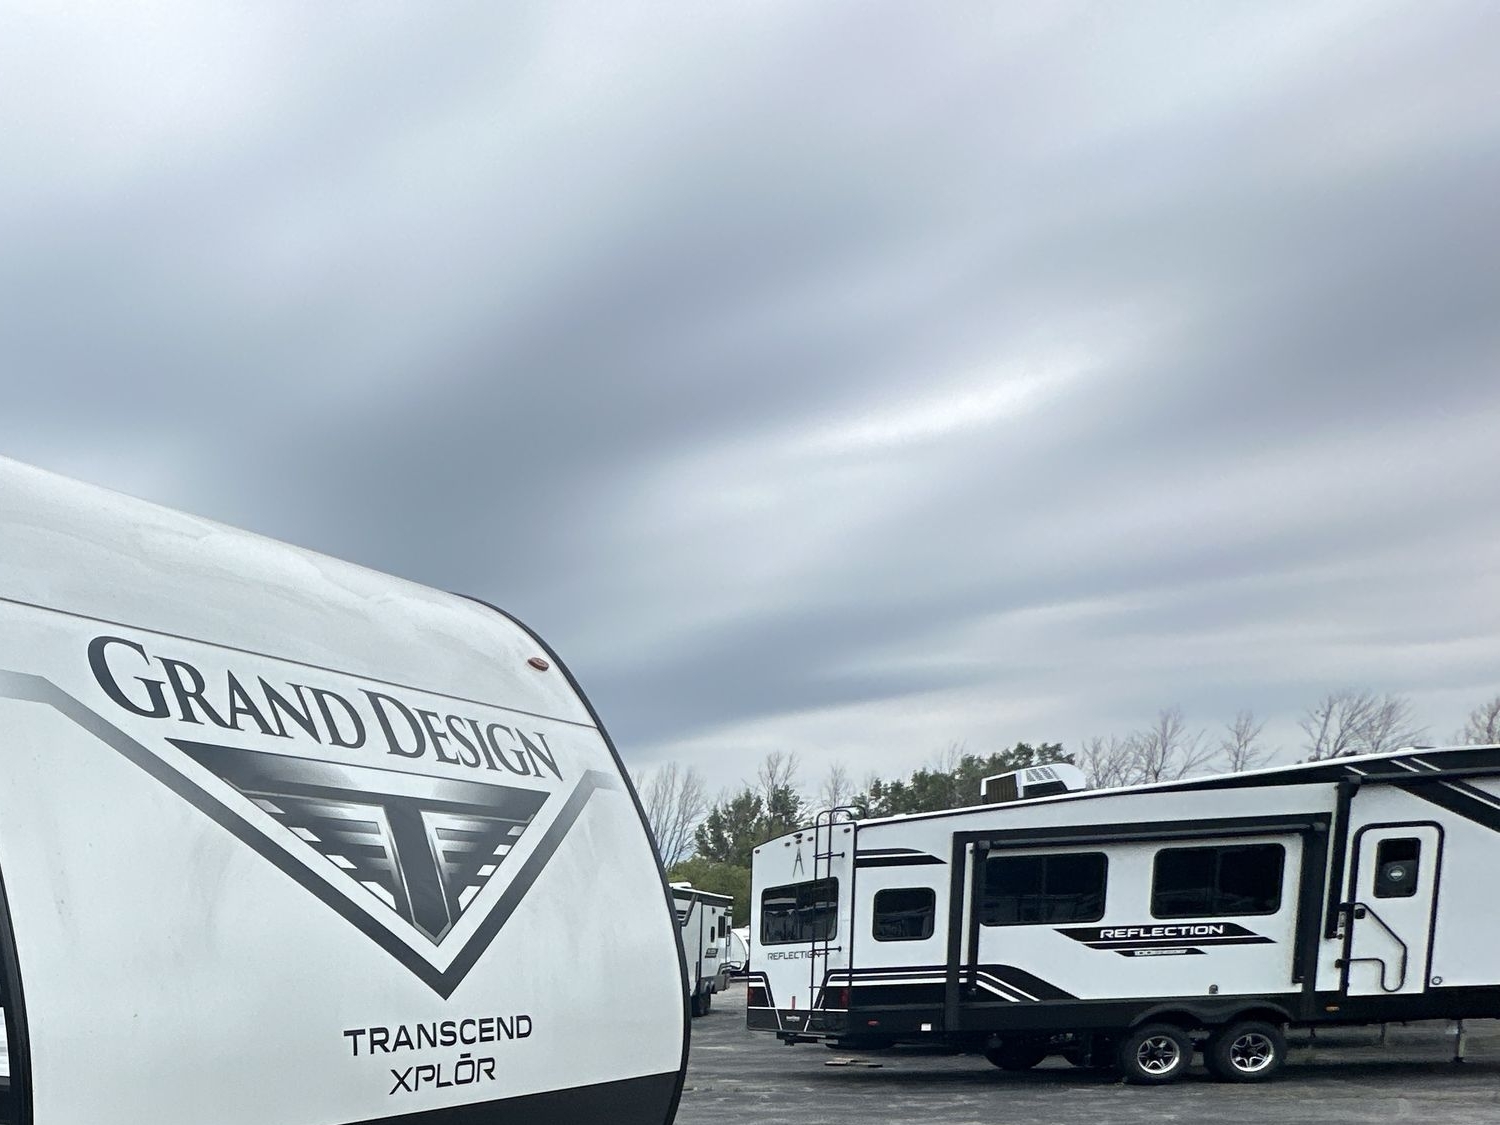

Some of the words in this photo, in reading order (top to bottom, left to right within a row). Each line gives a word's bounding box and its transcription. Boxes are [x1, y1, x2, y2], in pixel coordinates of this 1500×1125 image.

[87, 635, 367, 749] GRAND
[358, 688, 564, 782] DESIGN
[1099, 925, 1224, 939] REFLECTION
[343, 1014, 533, 1057] TRANSCEND
